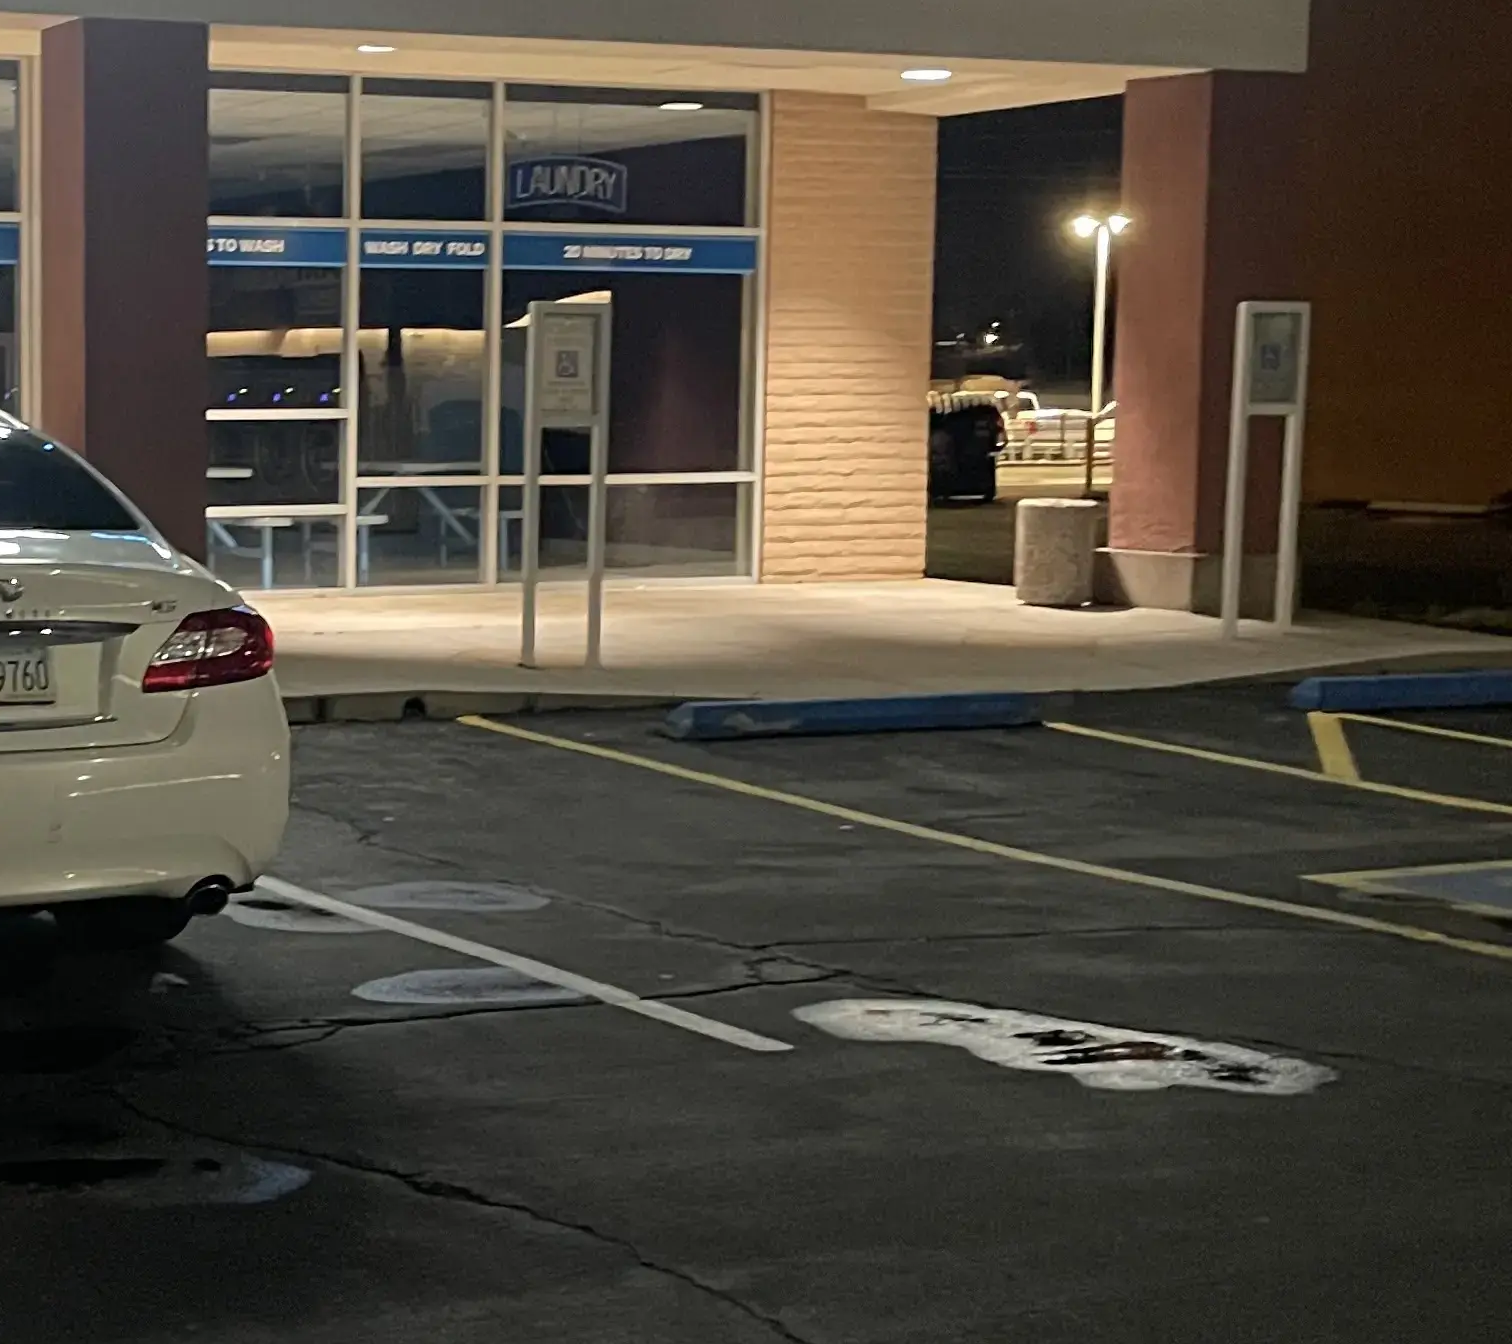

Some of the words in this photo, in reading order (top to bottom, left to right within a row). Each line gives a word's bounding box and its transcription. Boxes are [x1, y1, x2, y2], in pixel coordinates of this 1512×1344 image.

[516, 164, 616, 200] LAUNDRY
[217, 238, 237, 252] TO
[239, 239, 285, 253] WASH
[364, 241, 408, 255] WASH
[412, 241, 444, 256] DRY
[446, 242, 486, 257] FOLD
